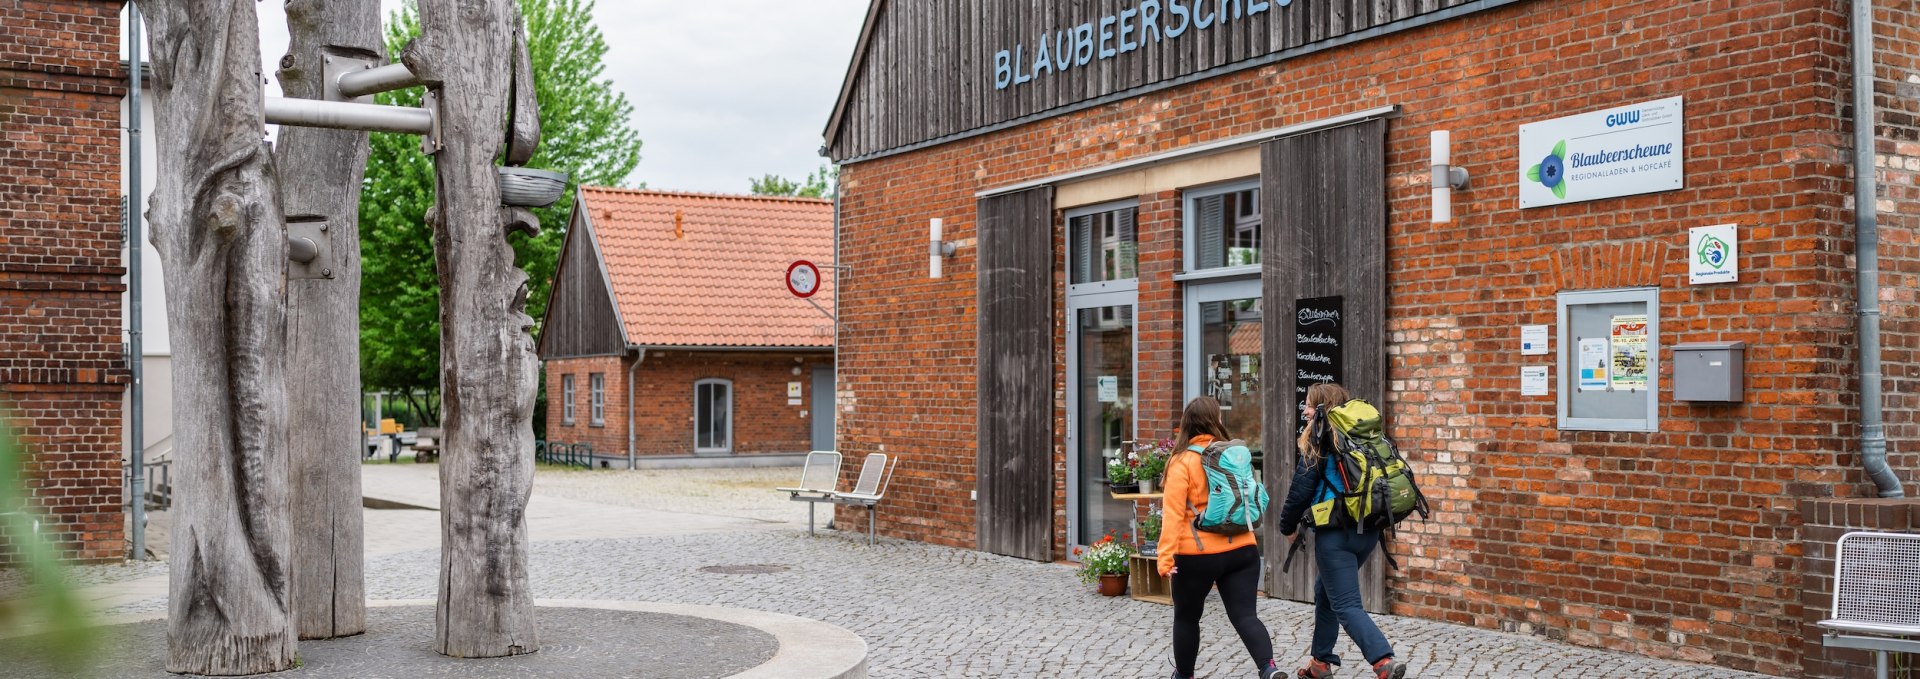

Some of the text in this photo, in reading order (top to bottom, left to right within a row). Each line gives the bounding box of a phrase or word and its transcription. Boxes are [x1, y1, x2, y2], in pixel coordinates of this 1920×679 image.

[994, 0, 1292, 90] BLAUBEERSCH
[1606, 109, 1640, 128] GWW
[1570, 142, 1673, 169] Blaubeerscheune
[1571, 160, 1672, 181] REGIONALLADEN & HOFCAFÉ
